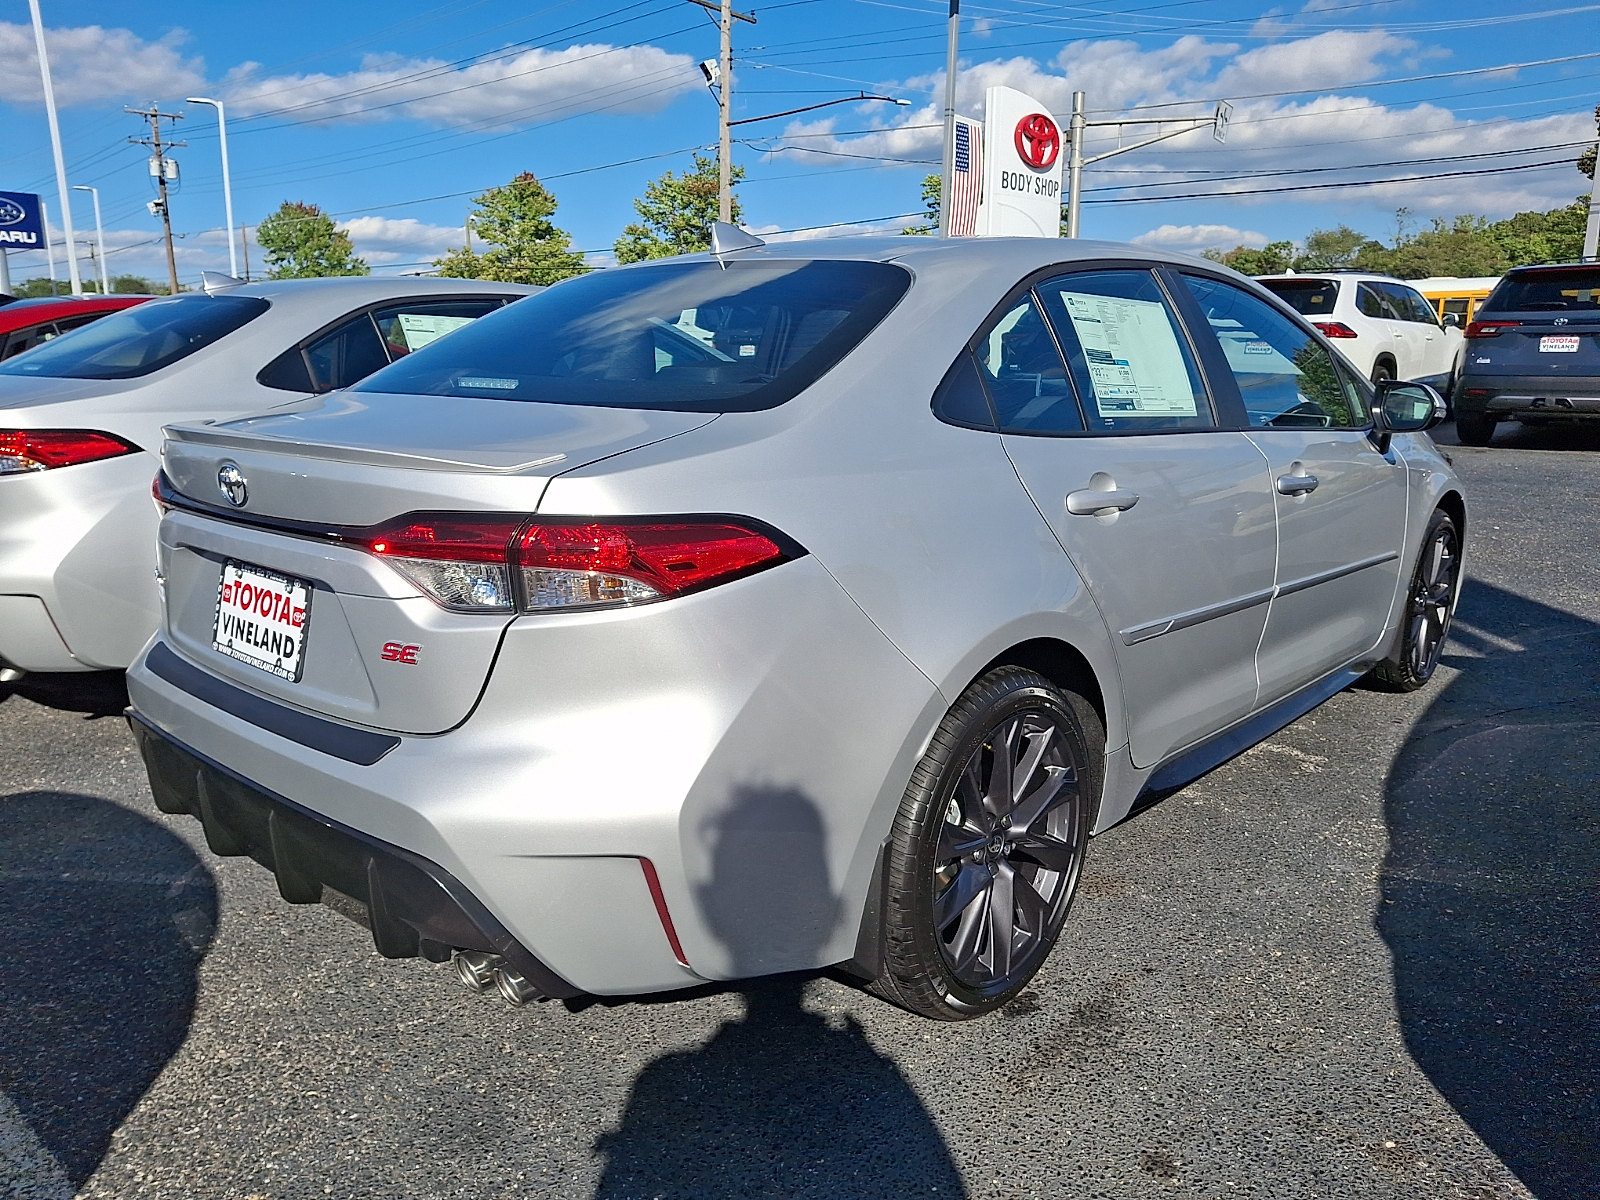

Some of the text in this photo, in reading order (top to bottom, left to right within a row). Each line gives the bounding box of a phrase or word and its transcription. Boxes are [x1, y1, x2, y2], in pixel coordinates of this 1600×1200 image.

[1001, 170, 1060, 198] BODY SHOP
[212, 575, 224, 631] TOYOTA
[232, 579, 291, 627] TOYOTA
[222, 611, 295, 659] VINELAND
[380, 640, 423, 666] SE
